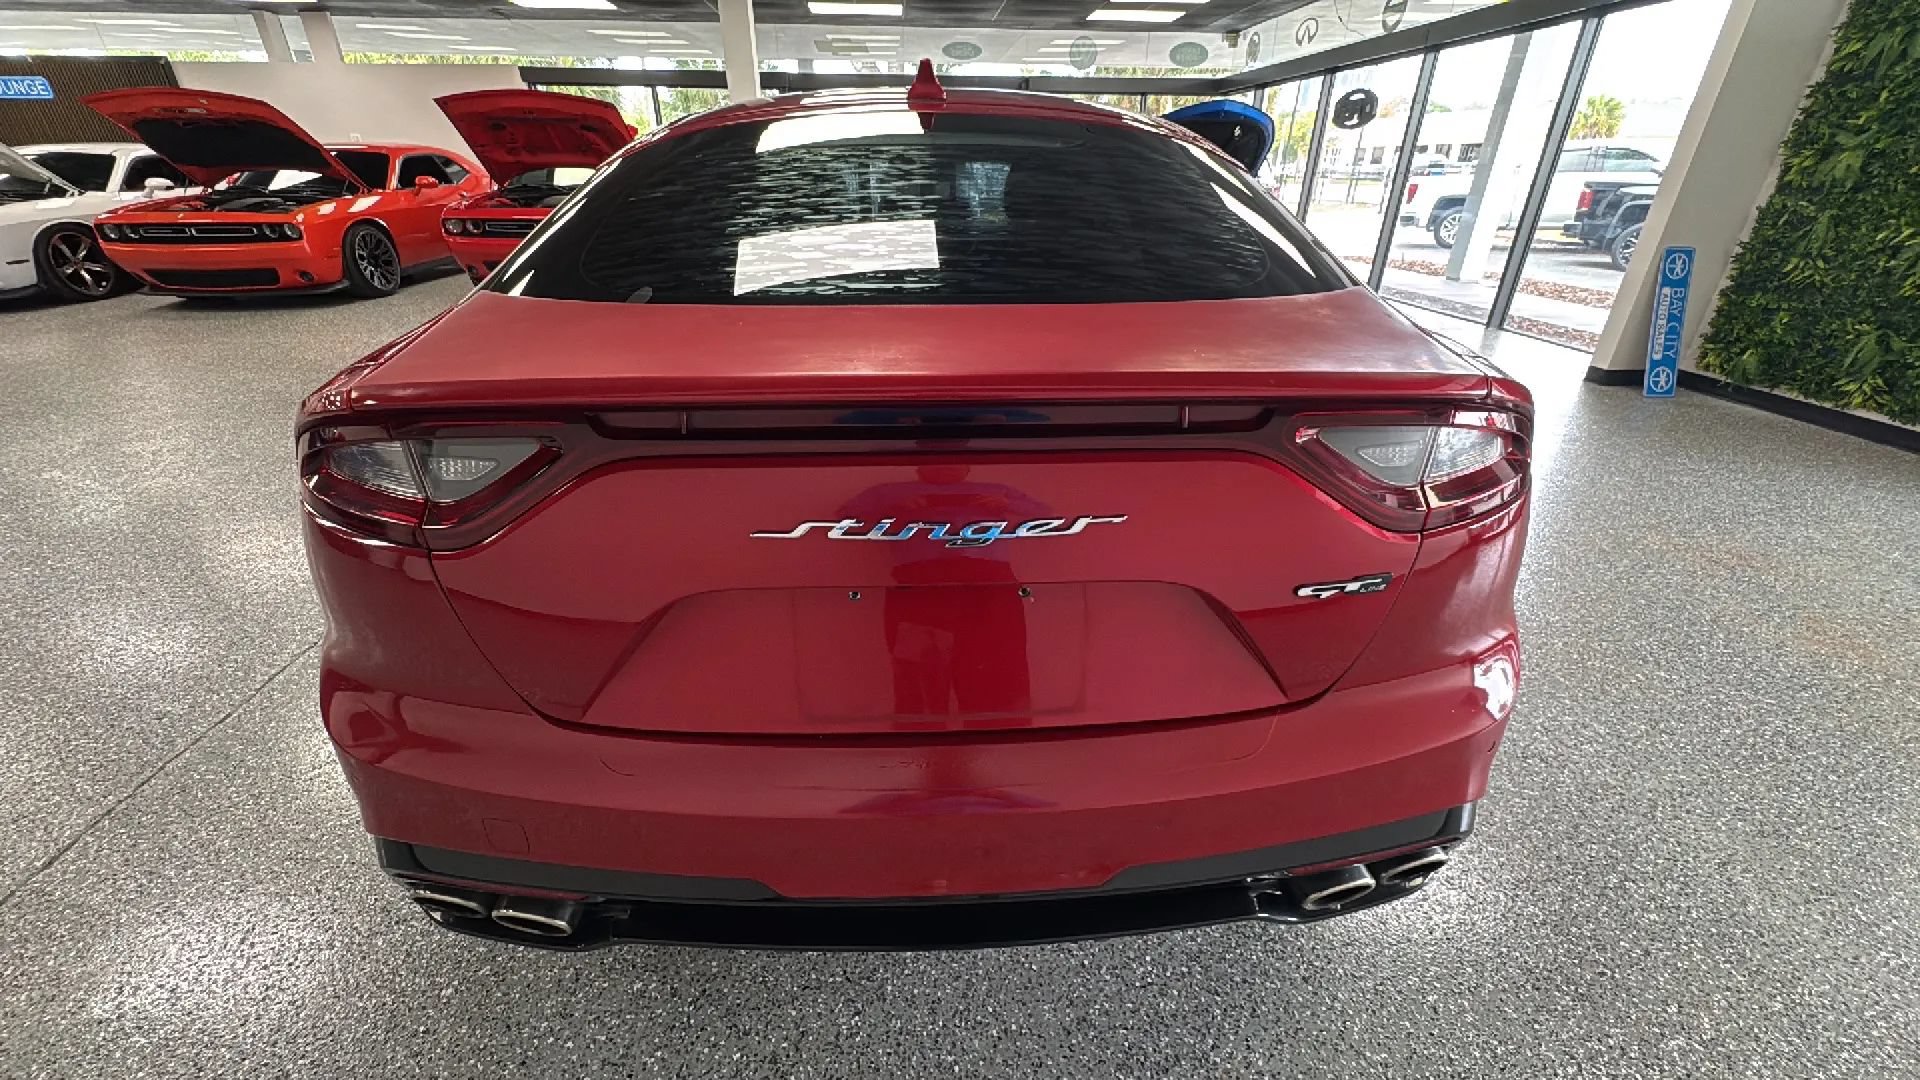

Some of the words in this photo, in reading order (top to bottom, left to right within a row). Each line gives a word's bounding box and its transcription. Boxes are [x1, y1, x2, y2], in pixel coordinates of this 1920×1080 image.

[0, 79, 49, 95] UNGE
[1657, 292, 1669, 321] AUTO
[1669, 287, 1685, 317] BAY
[1653, 322, 1665, 355] SALES
[1663, 323, 1680, 359] CITY
[749, 515, 1129, 548] stinger
[1297, 578, 1383, 599] GT
